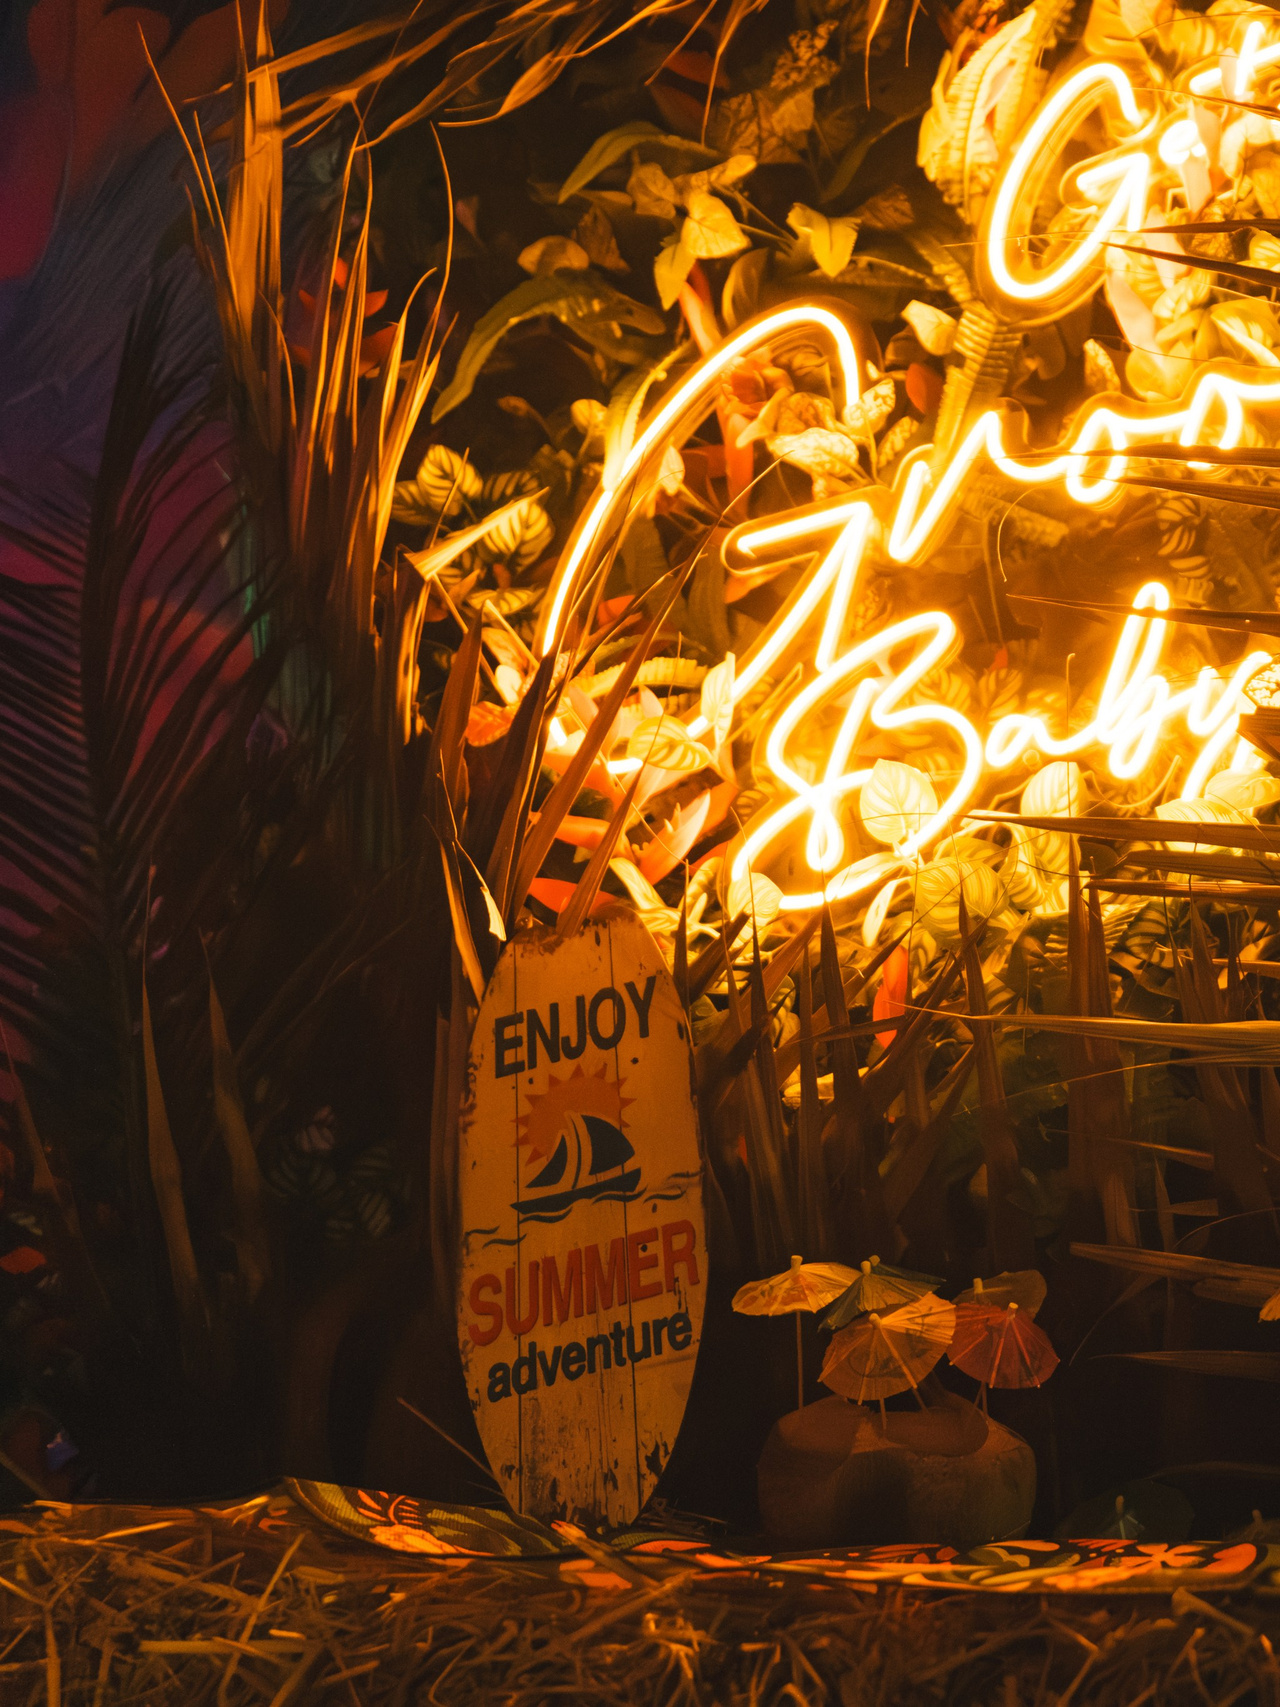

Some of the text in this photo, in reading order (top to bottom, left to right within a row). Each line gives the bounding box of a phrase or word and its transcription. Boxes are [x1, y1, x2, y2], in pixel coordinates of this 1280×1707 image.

[729, 580, 1275, 910] Baby
[495, 976, 657, 1078] ENJOY
[468, 1219, 700, 1346] SUMMER
[487, 1311, 693, 1401] adventure
